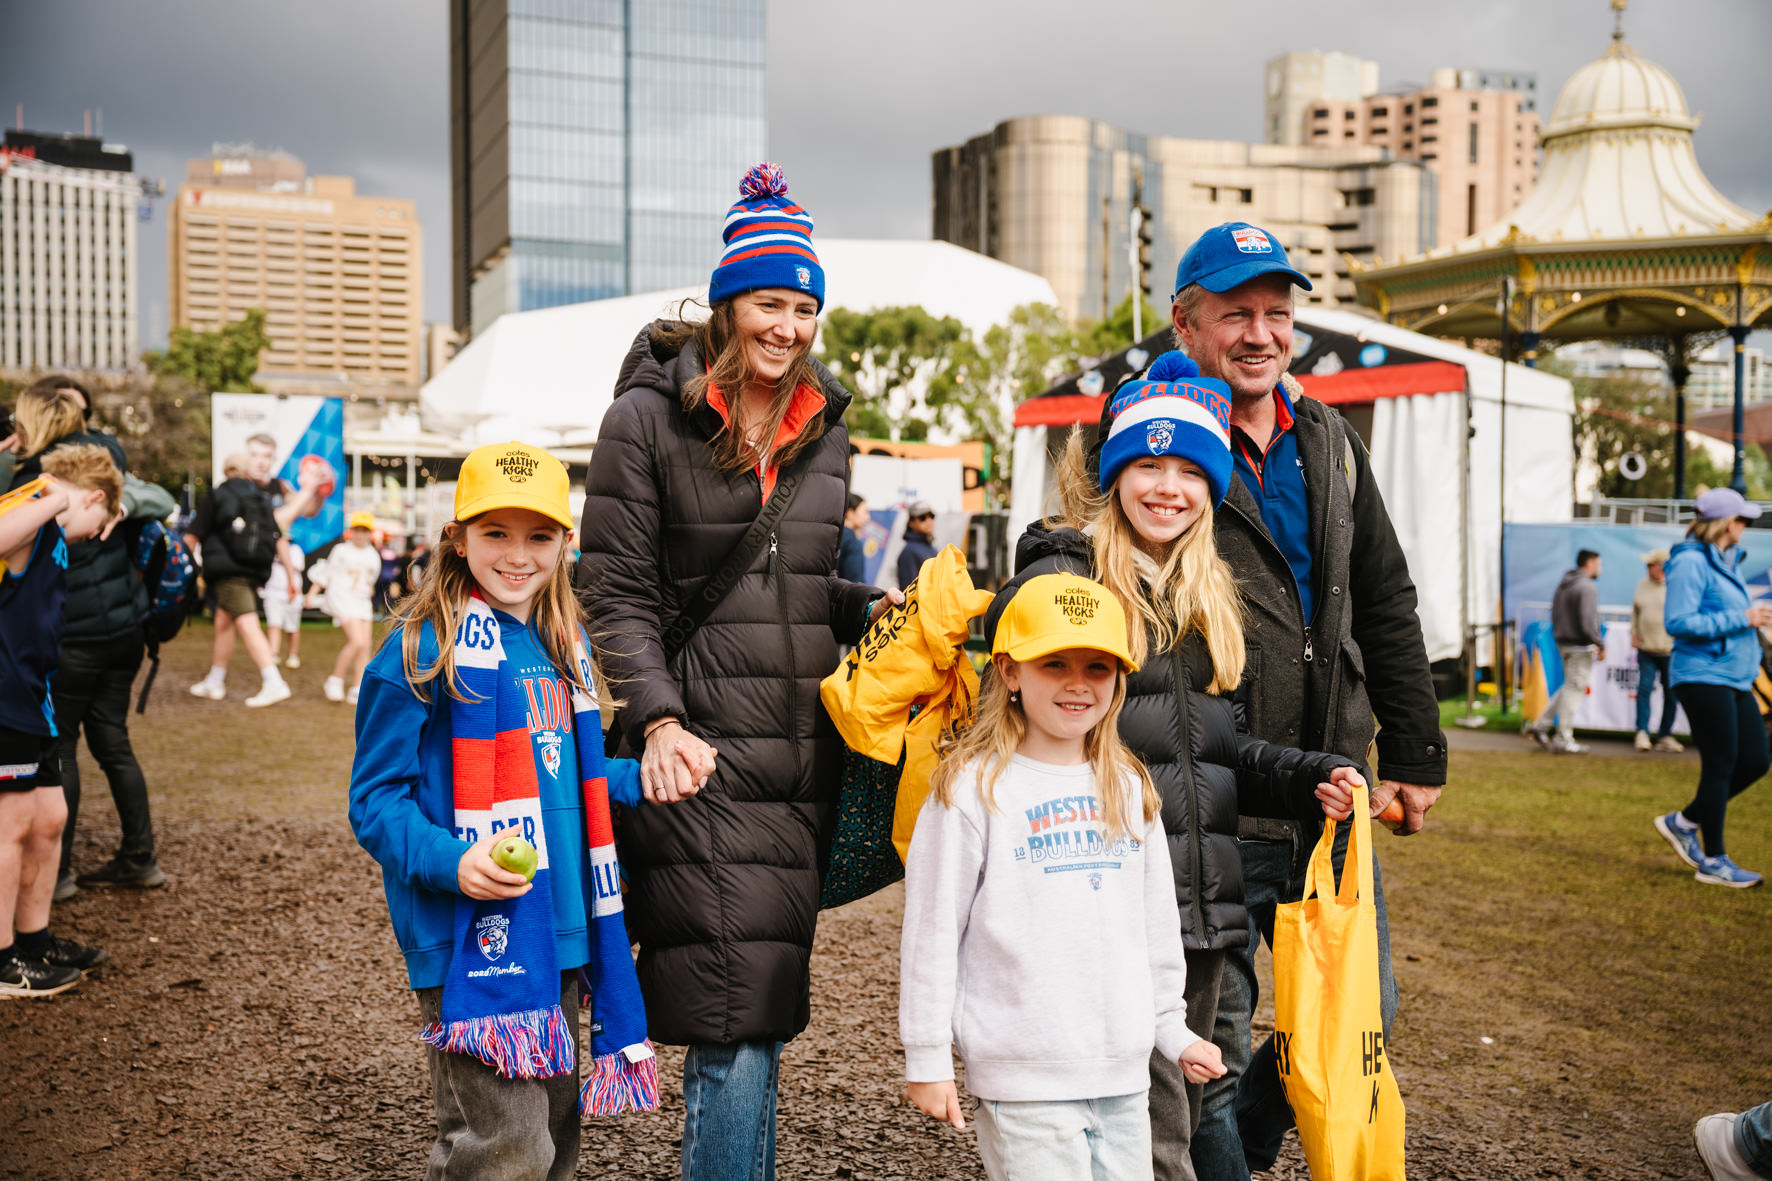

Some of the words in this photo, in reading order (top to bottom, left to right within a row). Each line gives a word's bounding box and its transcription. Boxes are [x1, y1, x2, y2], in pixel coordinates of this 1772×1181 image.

[506, 449, 531, 458] coles
[496, 456, 539, 469] HEALTHY
[503, 466, 533, 477] KICKS
[1065, 587, 1091, 596] coles
[1055, 595, 1100, 609] HEALTHY
[1063, 606, 1094, 618] KICKS
[864, 599, 918, 662] coles
[476, 918, 511, 929] BULLDOGS
